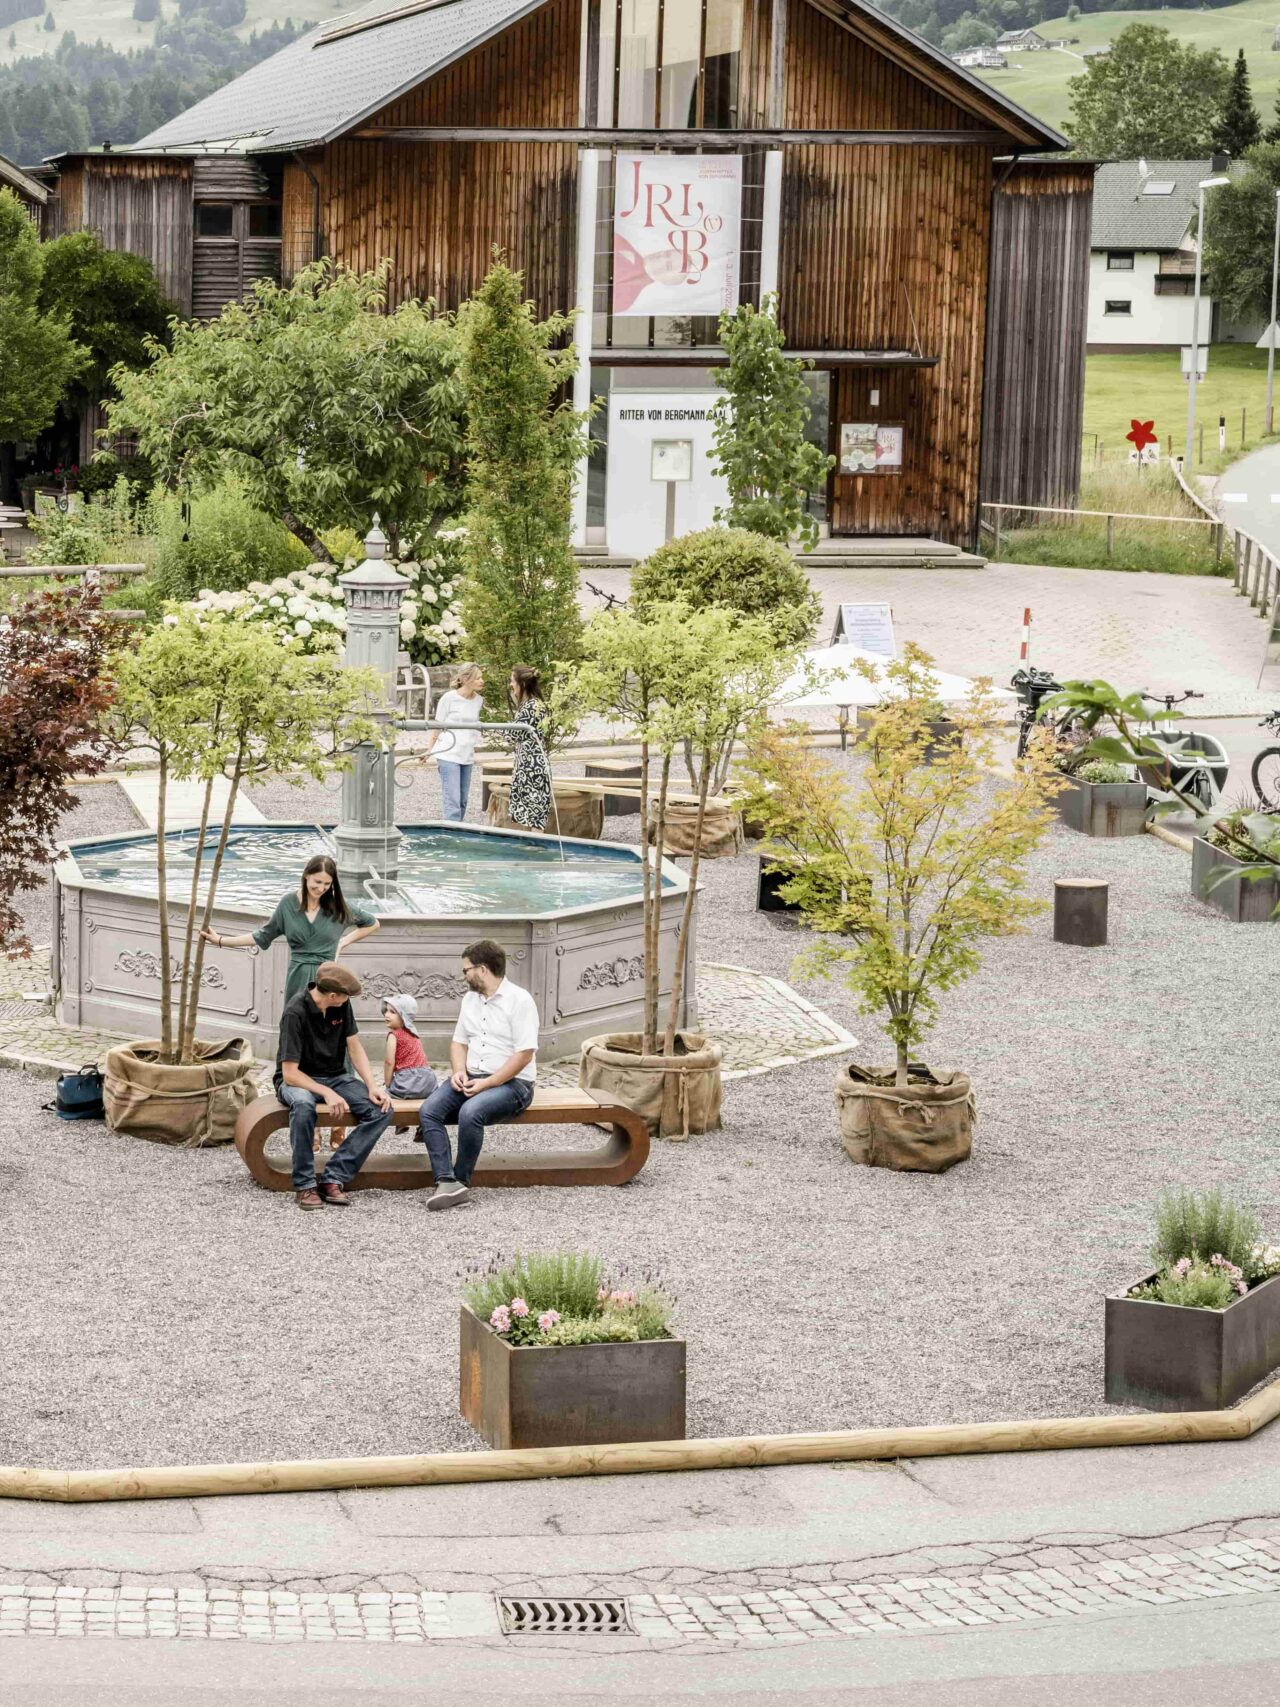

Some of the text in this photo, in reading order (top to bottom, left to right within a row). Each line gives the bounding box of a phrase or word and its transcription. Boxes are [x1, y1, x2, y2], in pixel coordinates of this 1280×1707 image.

[619, 409, 645, 421] RITTER
[647, 409, 663, 421] VON
[664, 409, 705, 421] BERGMANN
